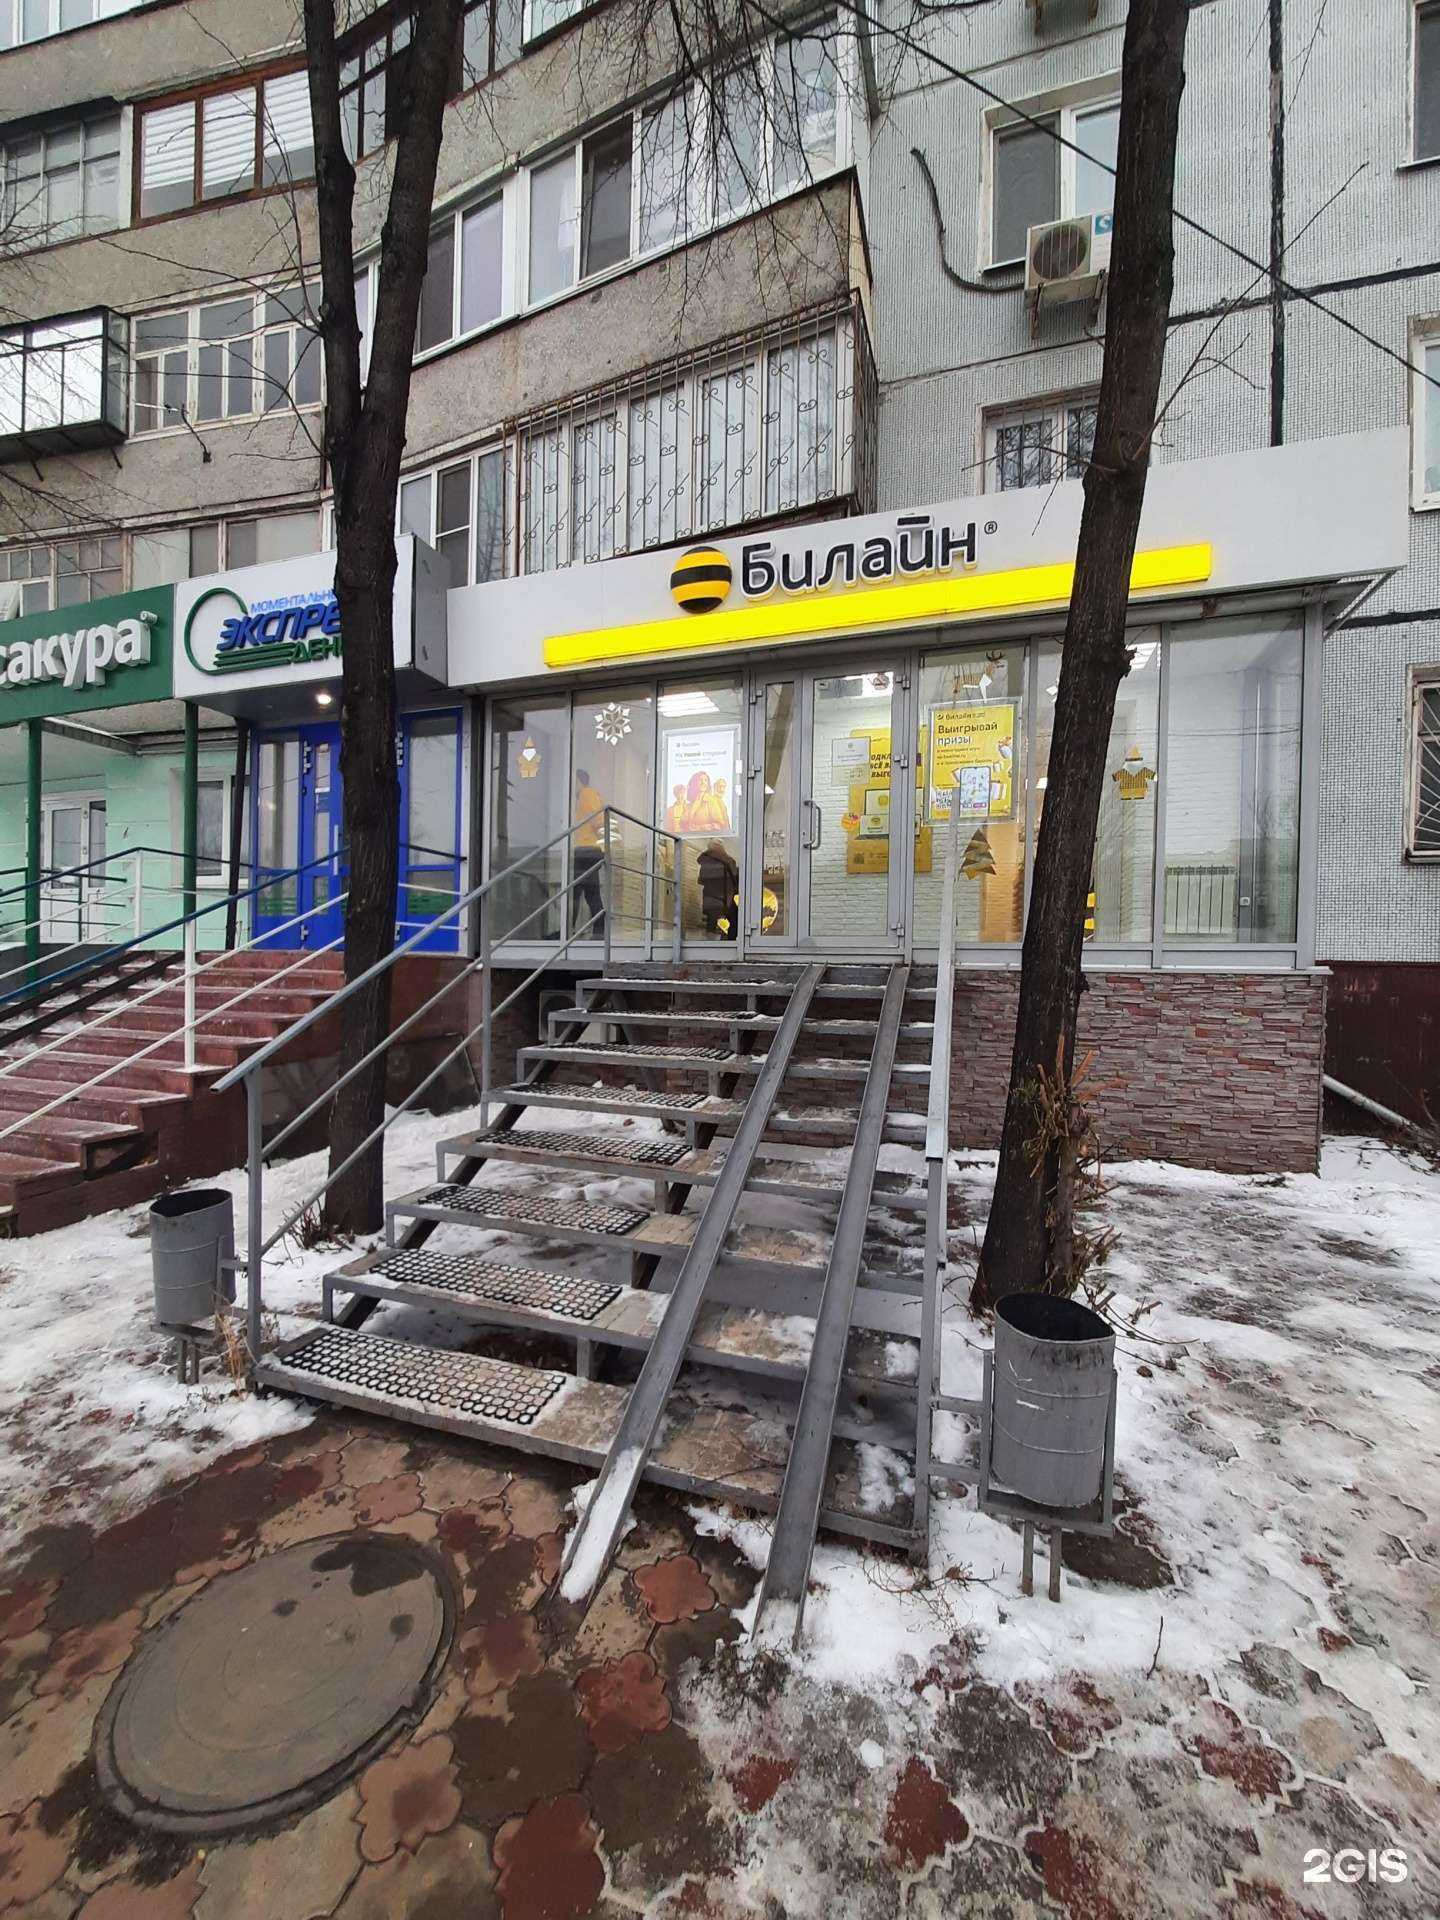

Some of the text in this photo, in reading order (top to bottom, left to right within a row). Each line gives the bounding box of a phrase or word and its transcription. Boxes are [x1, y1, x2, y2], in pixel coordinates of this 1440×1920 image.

[290, 636, 342, 664] ДЕН
[938, 722, 998, 734] Выигрывай
[937, 736, 971, 746] призы
